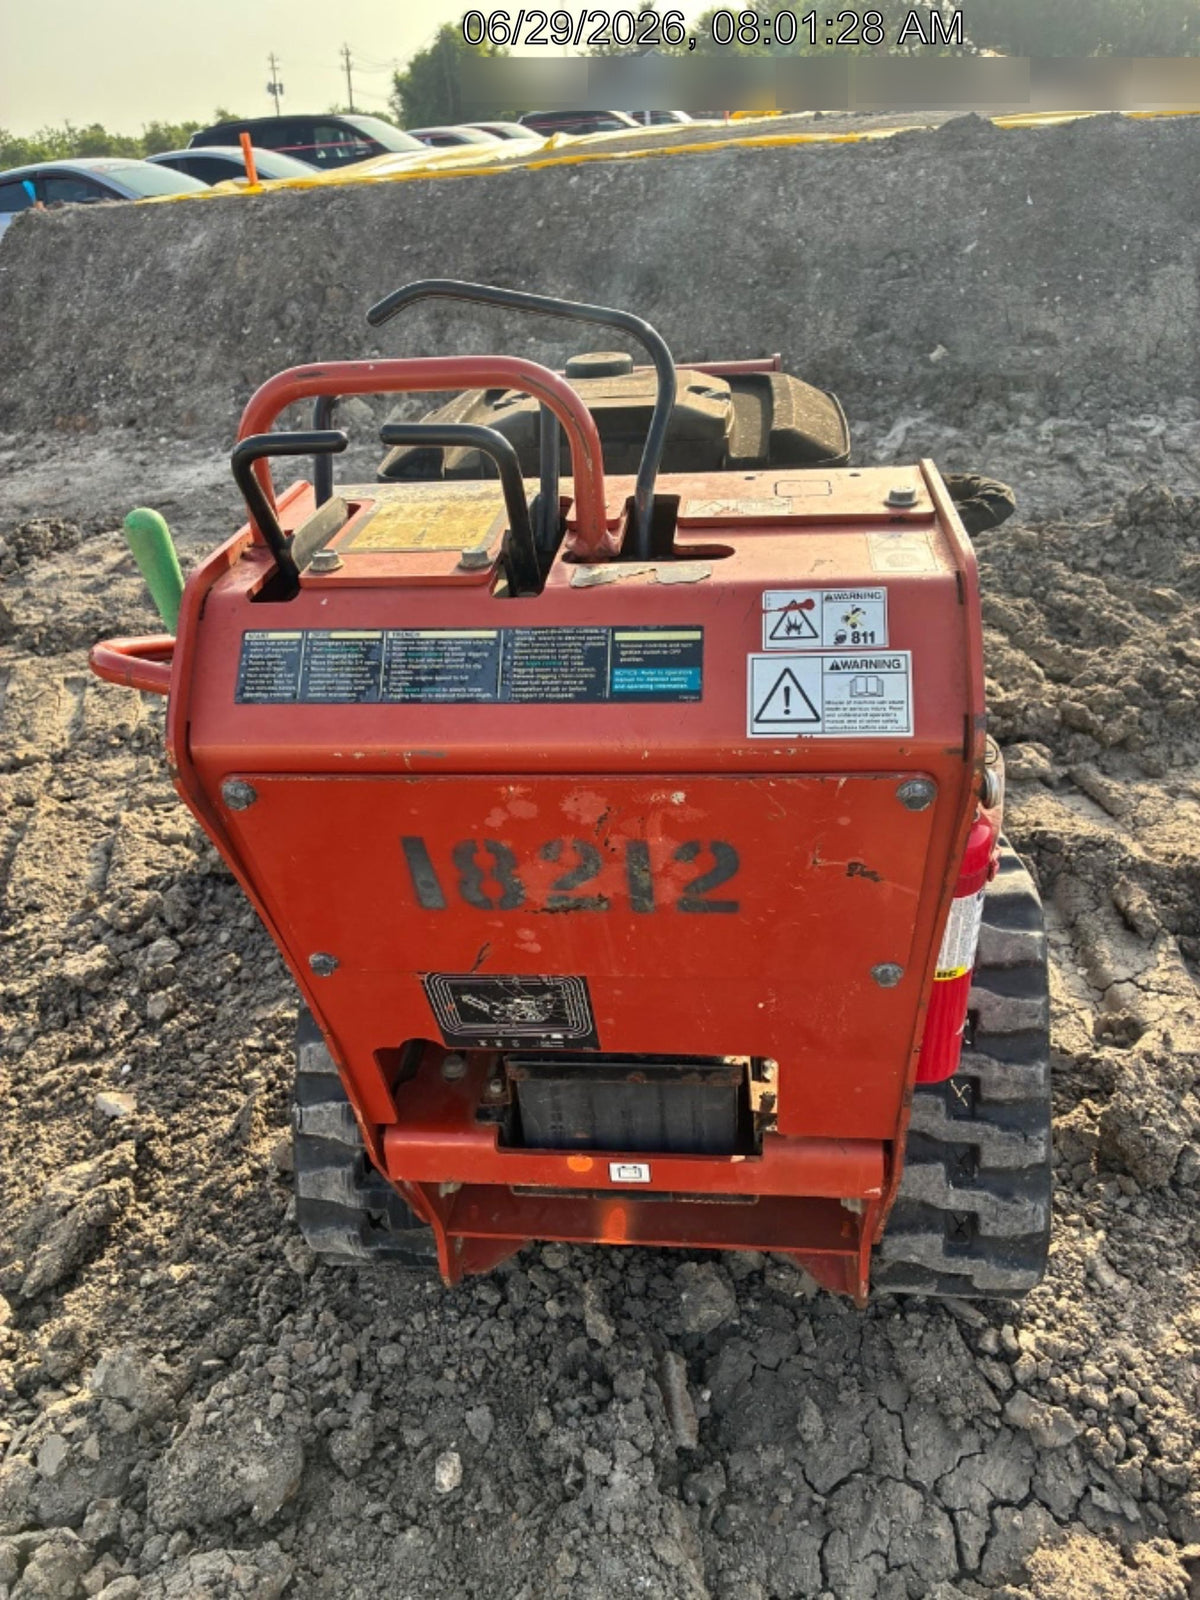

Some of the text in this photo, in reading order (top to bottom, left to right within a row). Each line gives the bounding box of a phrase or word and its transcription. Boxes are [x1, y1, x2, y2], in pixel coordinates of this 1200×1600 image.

[833, 592, 882, 601] WARNING
[851, 630, 875, 644] 811
[841, 659, 902, 670] WARNING
[400, 836, 740, 914] 18212
